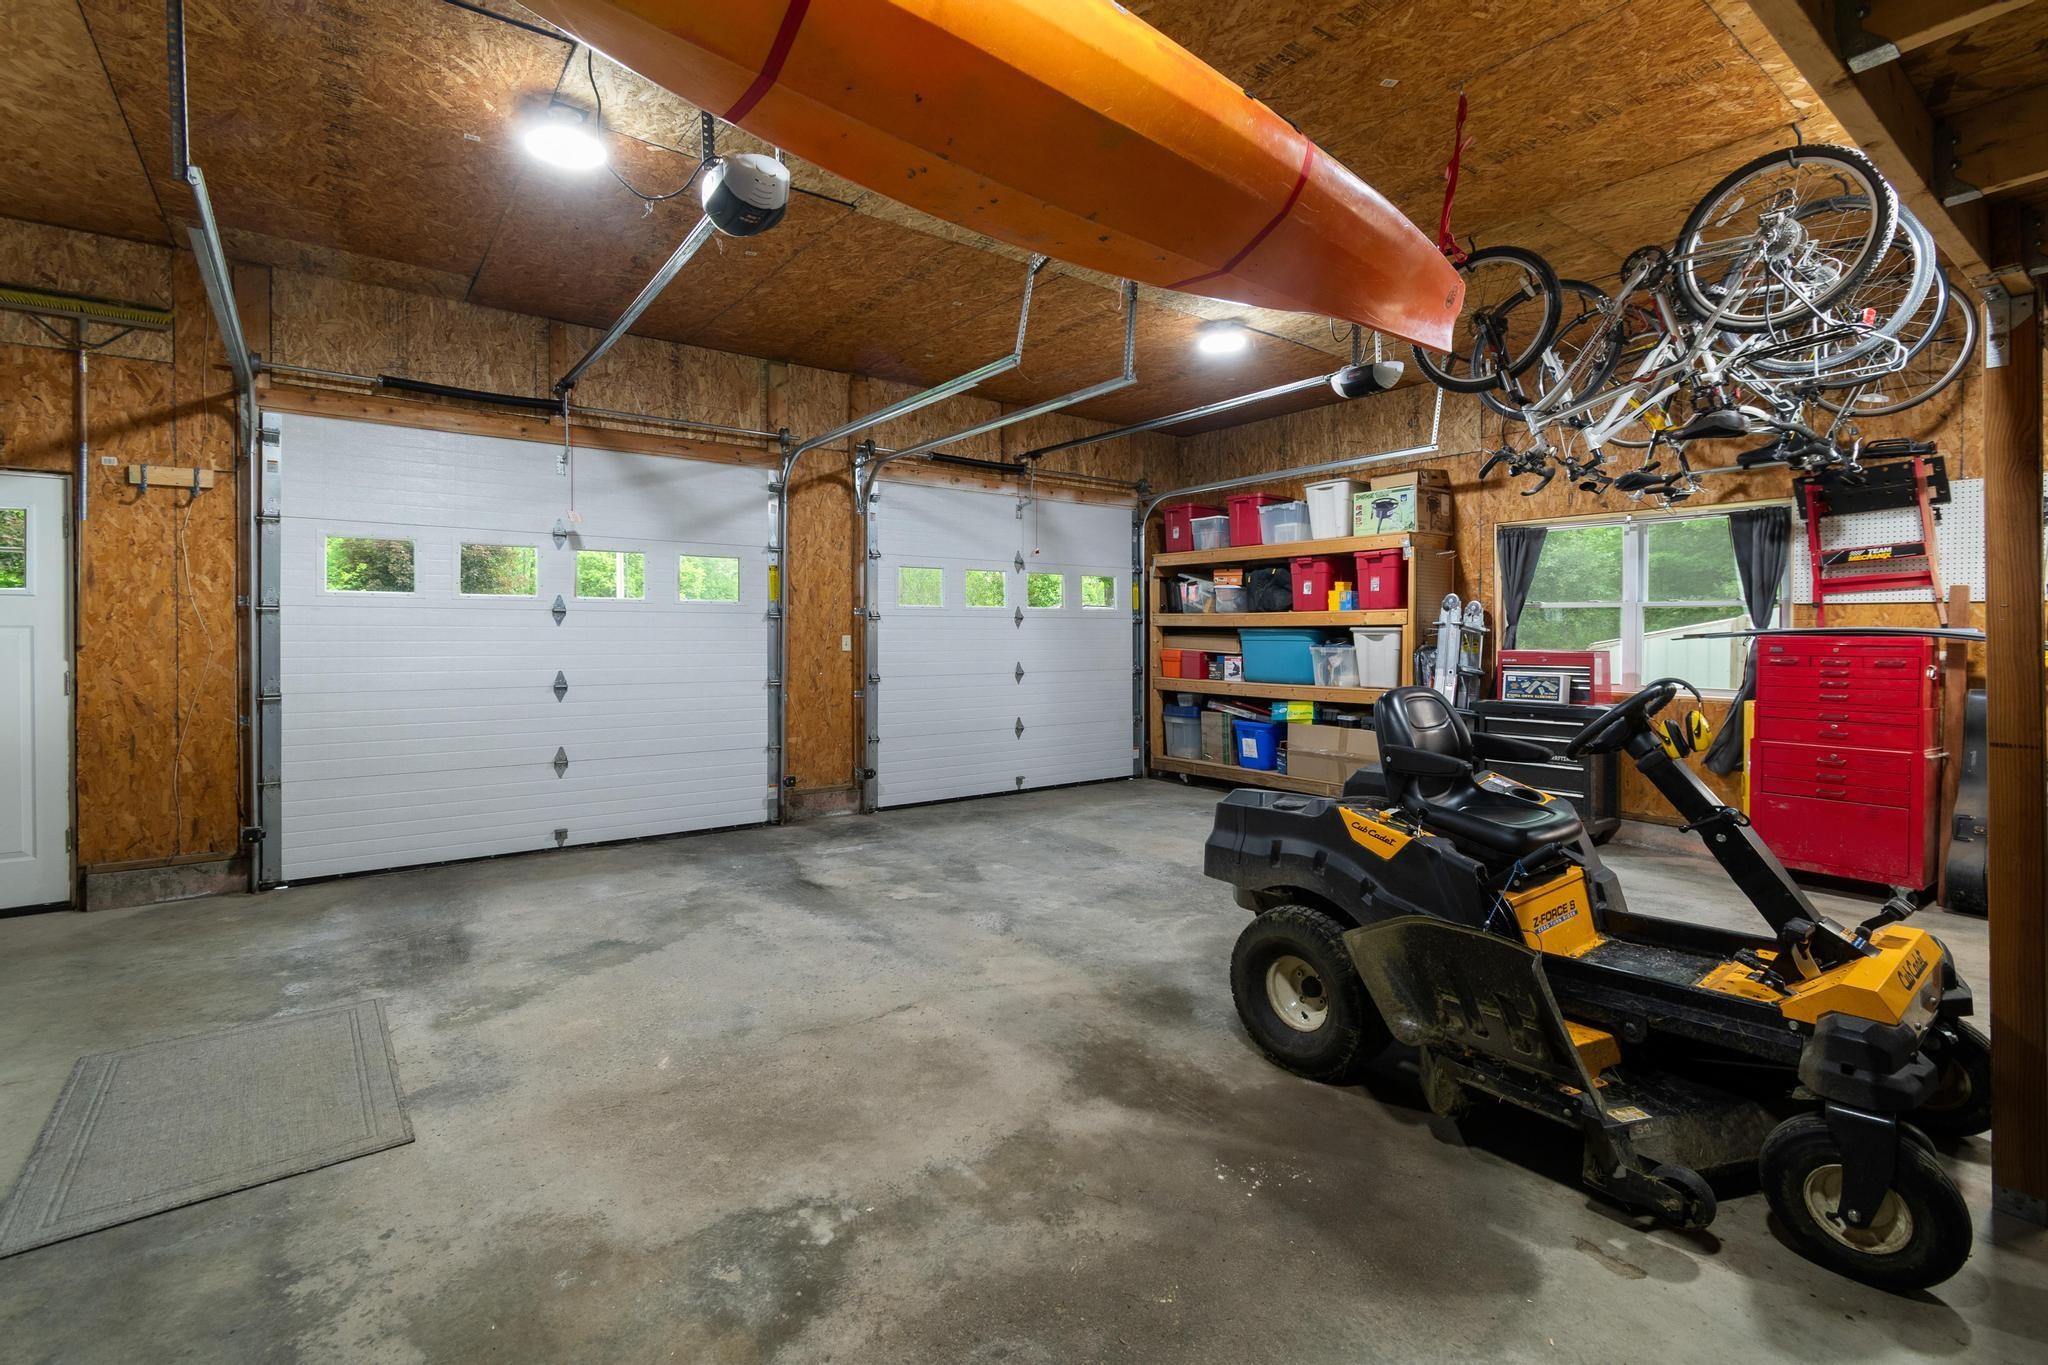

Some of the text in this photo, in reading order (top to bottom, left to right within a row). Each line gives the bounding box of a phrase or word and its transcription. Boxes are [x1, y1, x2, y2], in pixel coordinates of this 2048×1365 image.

[1568, 343, 1596, 381] FISHER
[1867, 547, 1892, 555] TEAM
[1351, 821, 1396, 847] Cub Cadet
[1533, 900, 1576, 928] Z-FORCE S
